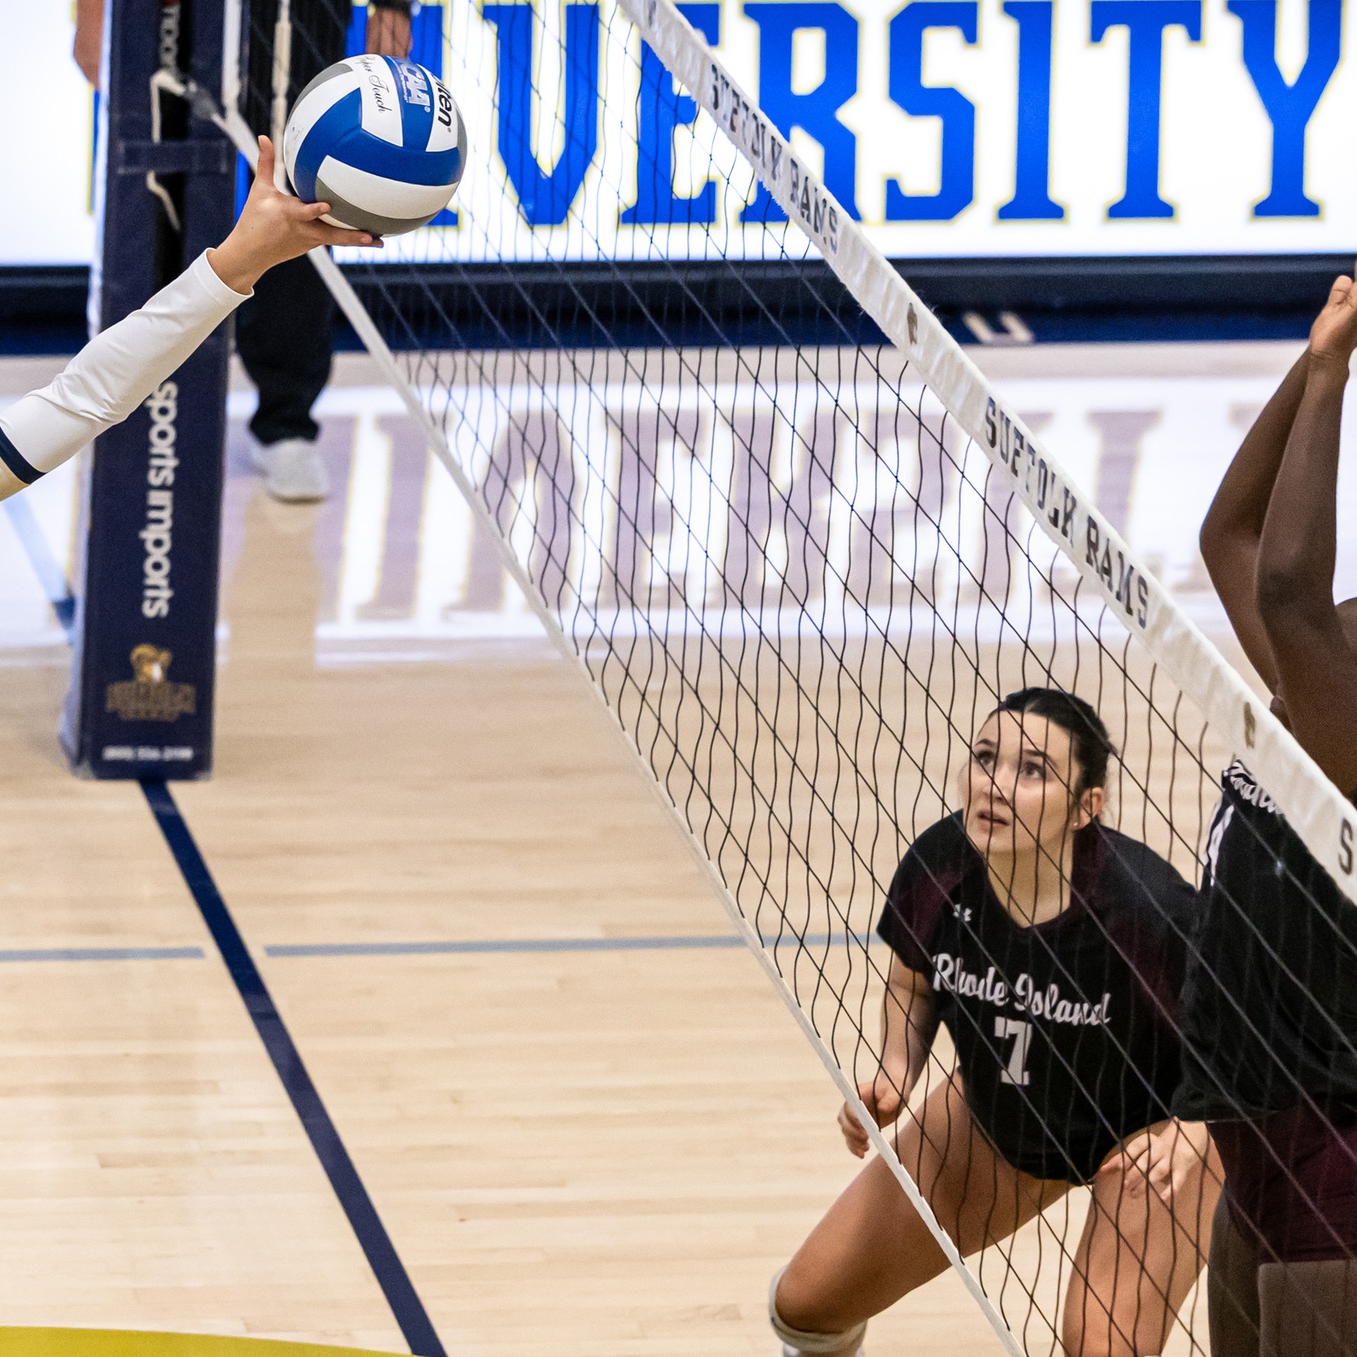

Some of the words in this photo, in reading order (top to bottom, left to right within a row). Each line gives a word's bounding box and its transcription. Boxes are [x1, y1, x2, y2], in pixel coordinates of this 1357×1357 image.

[89, 2, 1345, 224] VERSITY
[369, 75, 392, 113] Touch
[400, 61, 430, 107] CAA
[431, 74, 452, 127] lten
[145, 381, 178, 487] sports
[140, 490, 174, 618] imports
[932, 953, 1009, 1007] Rhode
[1013, 973, 1112, 1026] Island
[994, 1016, 1032, 1085] 7
